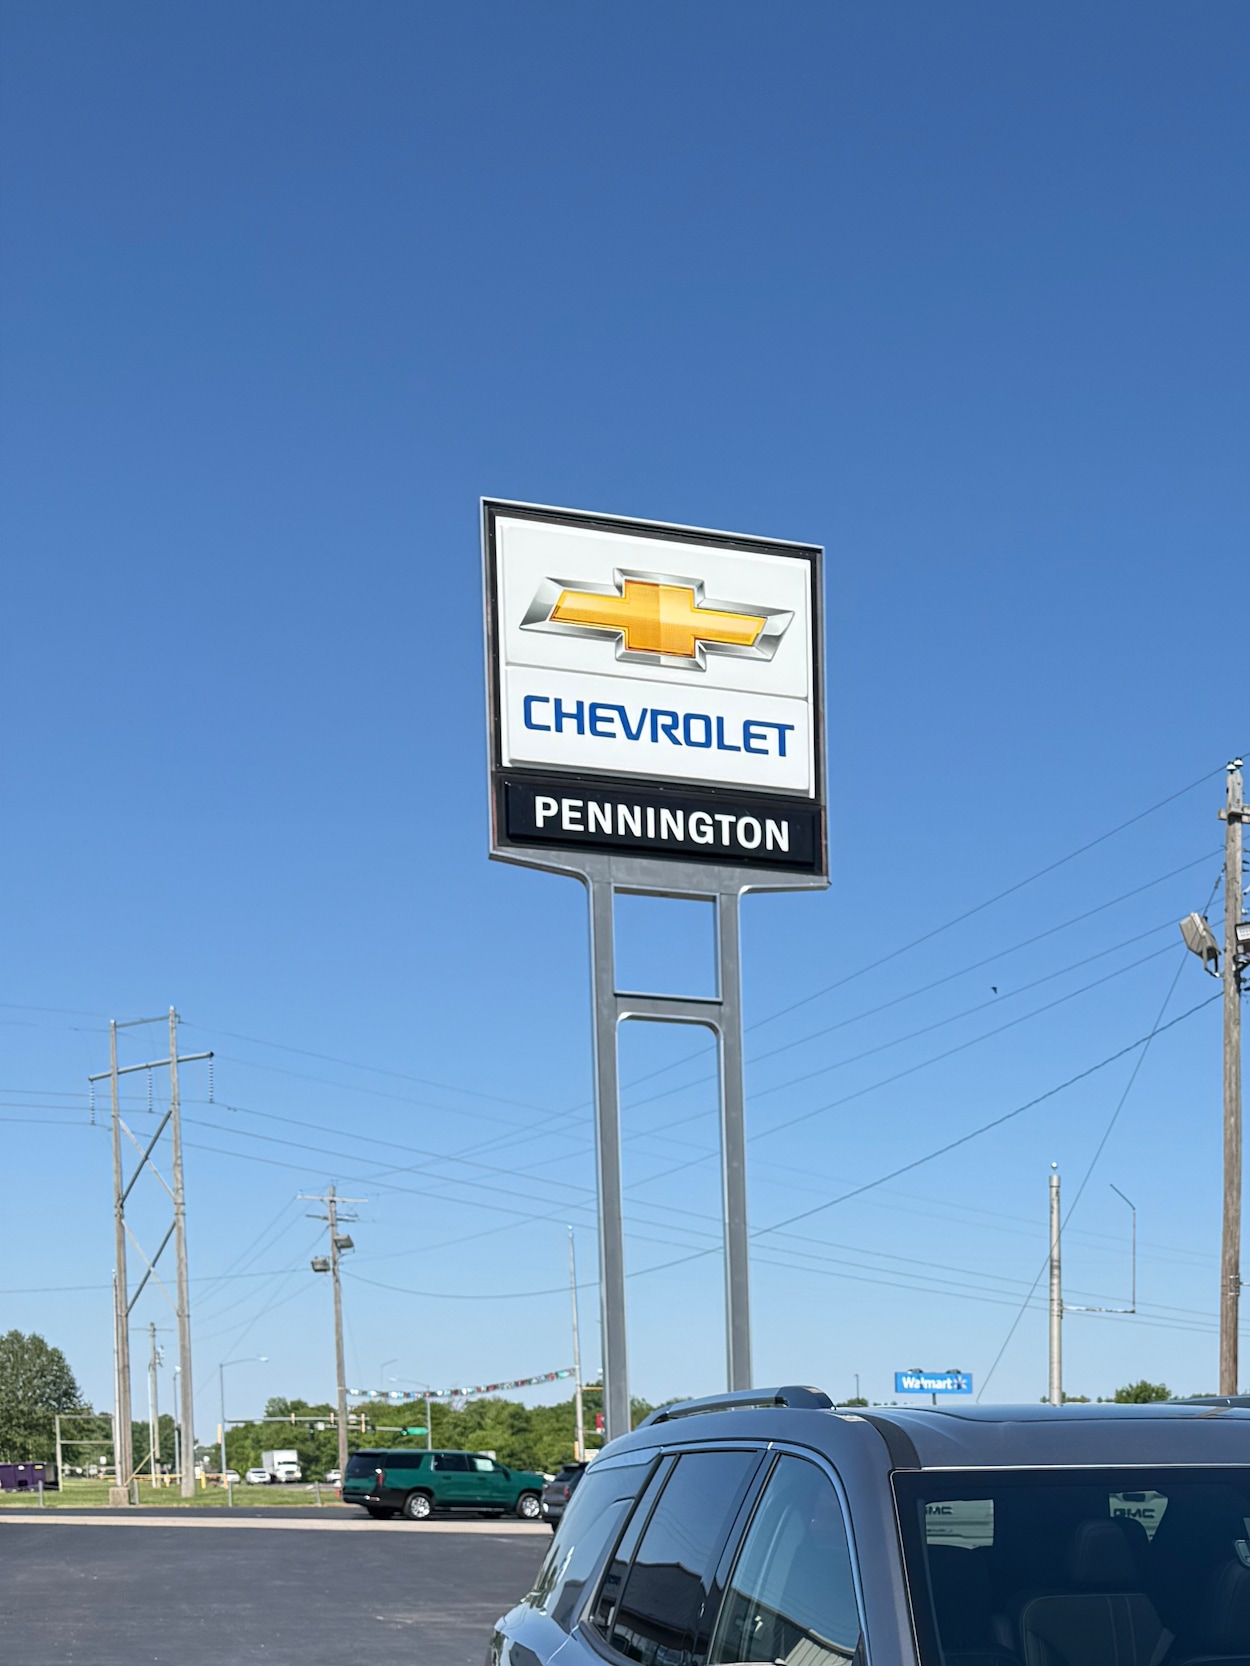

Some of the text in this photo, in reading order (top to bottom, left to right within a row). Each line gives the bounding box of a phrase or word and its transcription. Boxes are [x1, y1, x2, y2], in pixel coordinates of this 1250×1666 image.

[523, 695, 794, 757] CHEVROLET
[535, 795, 790, 852] PENNINGTON
[902, 1376, 953, 1389] Walmart
